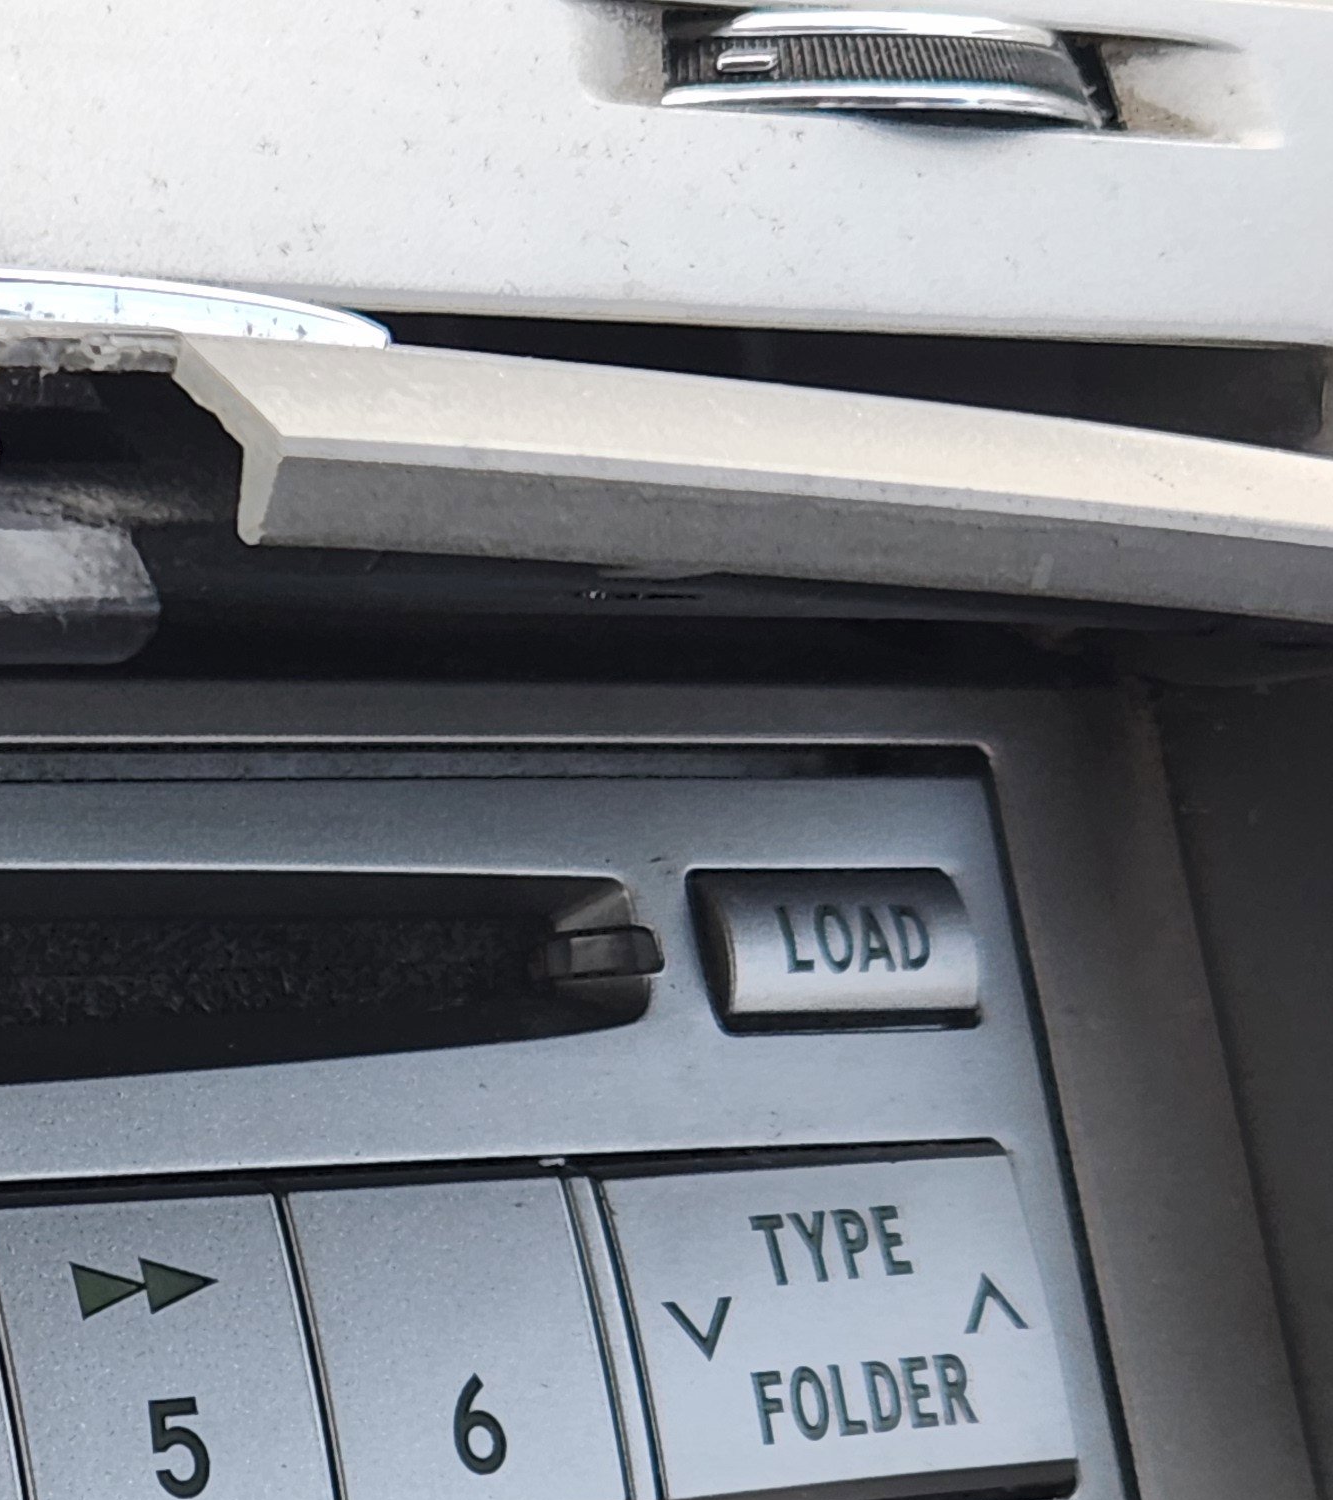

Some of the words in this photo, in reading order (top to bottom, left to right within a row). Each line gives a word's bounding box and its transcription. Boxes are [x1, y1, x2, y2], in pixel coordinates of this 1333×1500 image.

[775, 903, 931, 973] LOAD
[749, 1204, 914, 1286] TYPE
[453, 1372, 507, 1475] 6
[750, 1353, 980, 1445] FOLDER
[148, 1396, 210, 1498] 5
